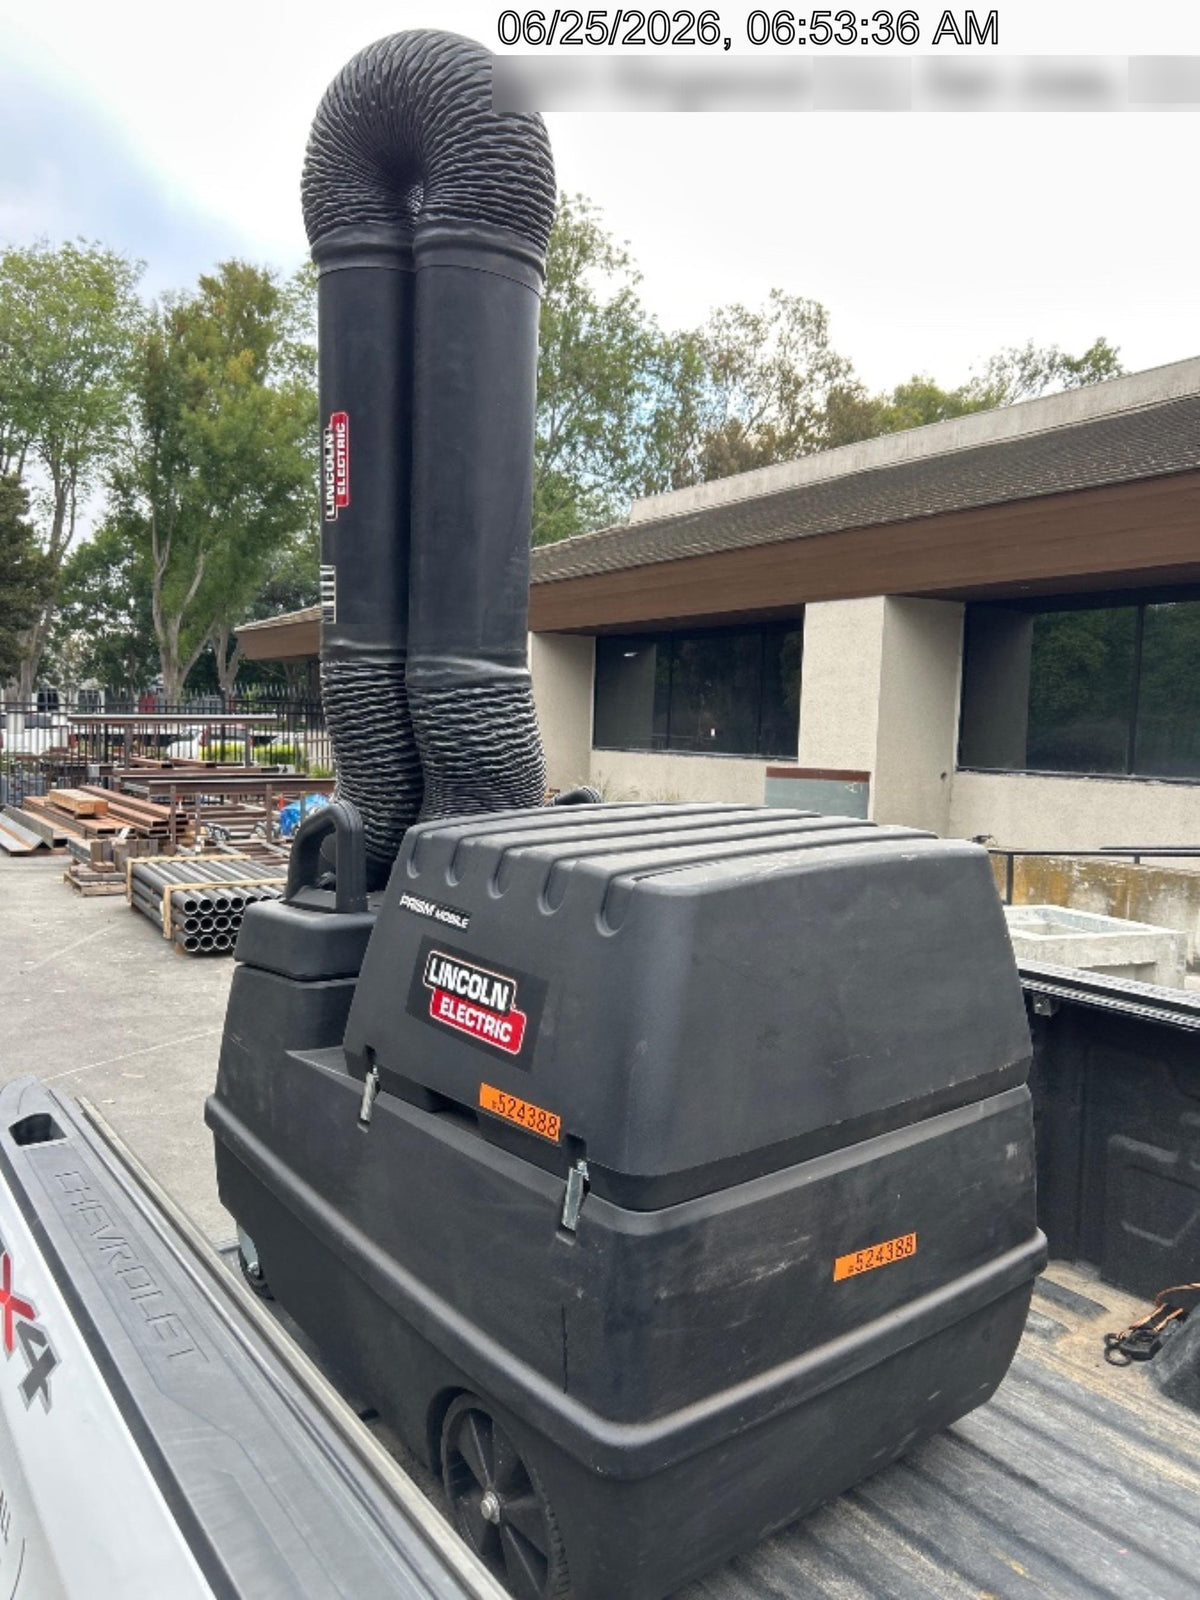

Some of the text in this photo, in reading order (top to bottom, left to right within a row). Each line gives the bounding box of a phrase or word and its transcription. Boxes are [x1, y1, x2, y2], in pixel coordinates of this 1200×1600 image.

[325, 432, 335, 517] LINCOLN
[336, 421, 346, 496] ELECTRIC
[399, 892, 436, 917] PRISM
[427, 957, 510, 1012] LINCOLN
[439, 996, 513, 1043] ELECTRIC
[54, 1170, 209, 1363] CHEVROLET
